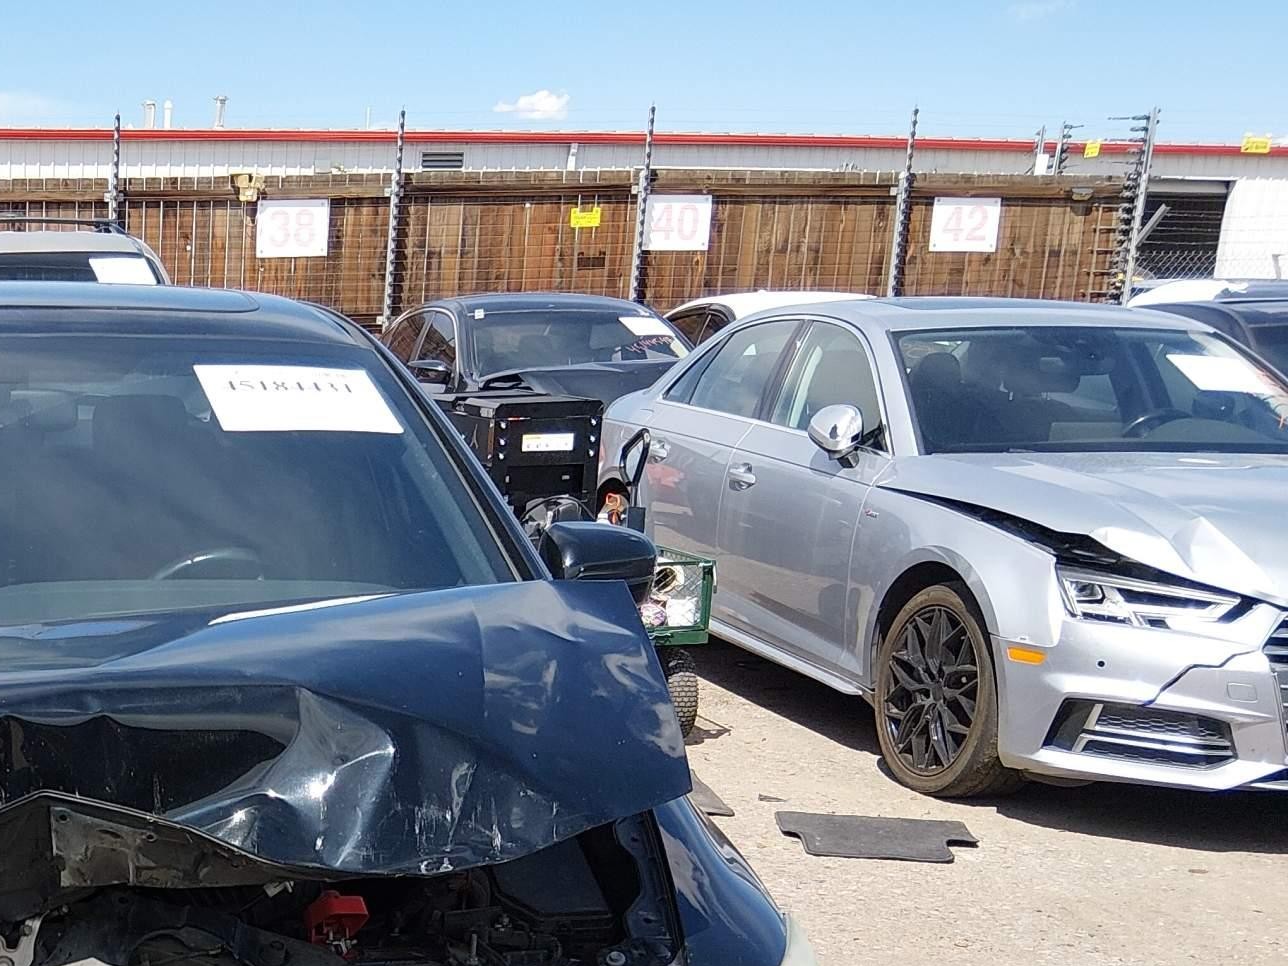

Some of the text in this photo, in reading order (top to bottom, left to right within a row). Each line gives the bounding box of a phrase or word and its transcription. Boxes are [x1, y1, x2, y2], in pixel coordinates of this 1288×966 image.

[270, 209, 314, 247] 38
[652, 204, 698, 240] 40
[942, 205, 988, 241] 42
